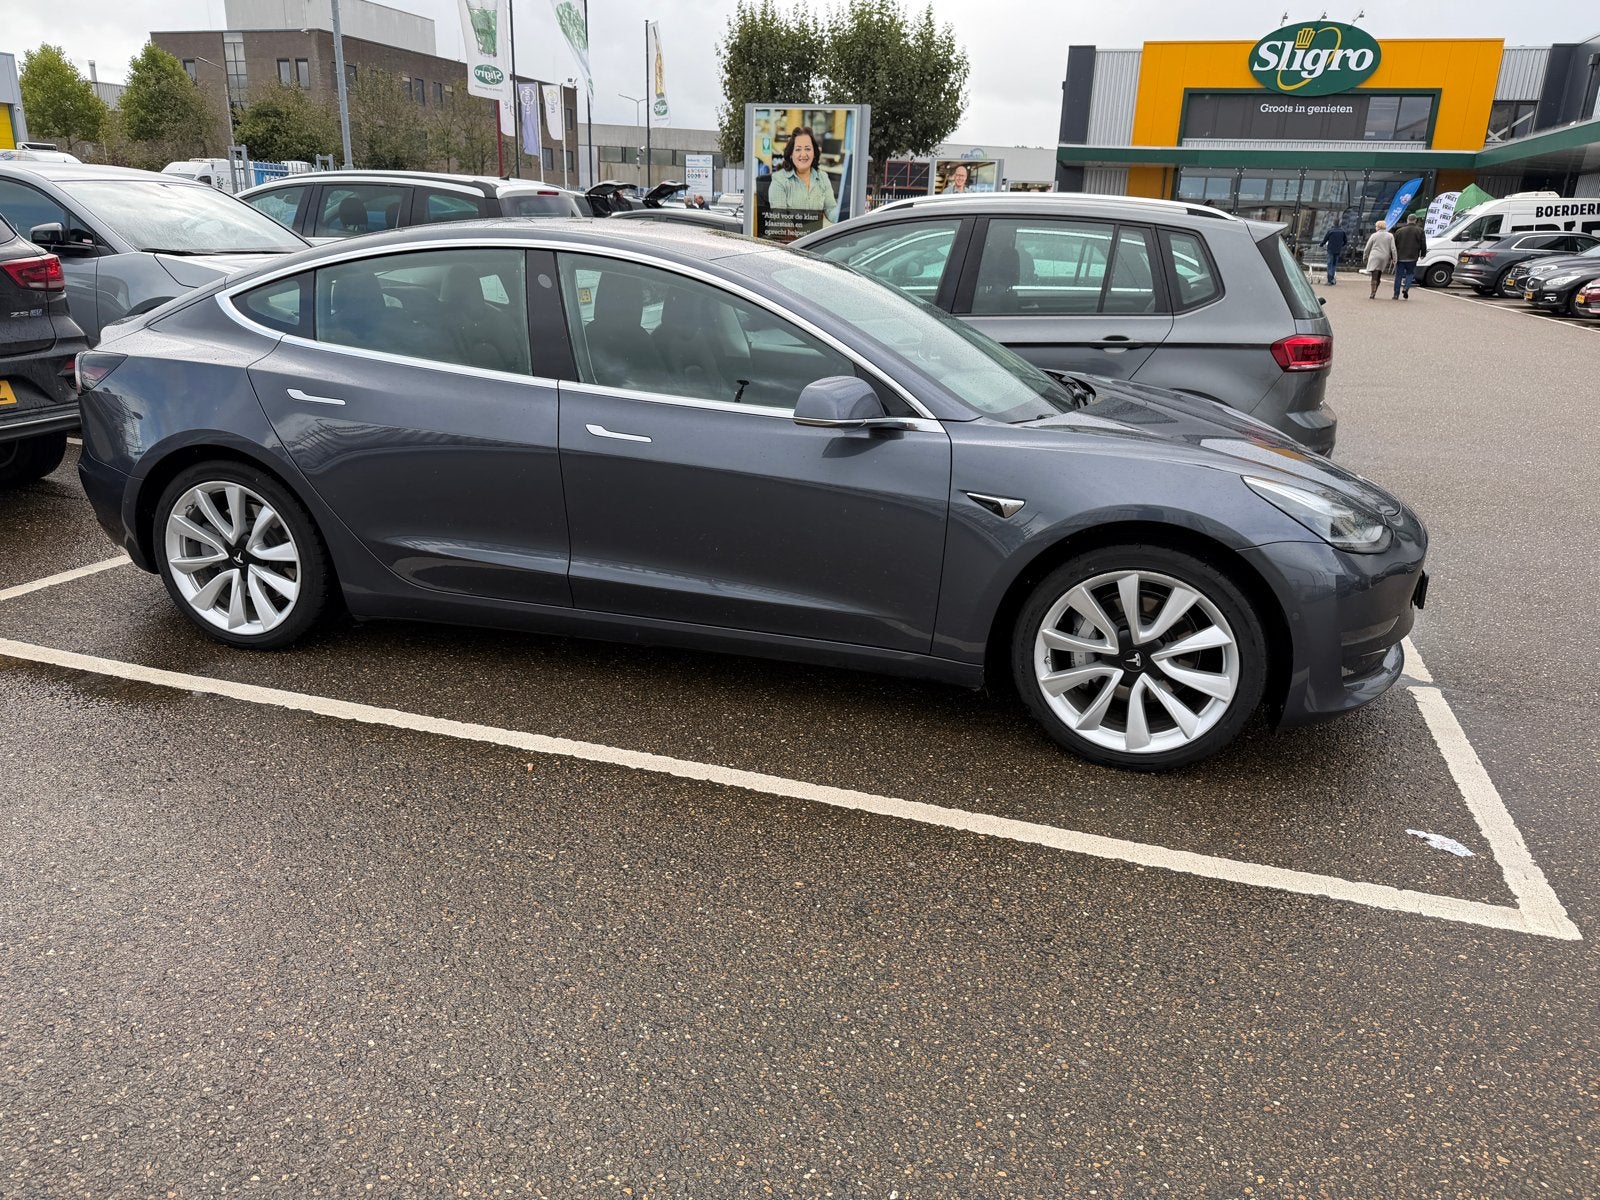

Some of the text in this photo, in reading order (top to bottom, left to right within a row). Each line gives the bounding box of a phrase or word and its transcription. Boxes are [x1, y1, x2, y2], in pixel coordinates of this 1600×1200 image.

[1253, 41, 1374, 79] Sligro
[1260, 103, 1353, 115] Groots in genieten
[804, 213, 819, 221] klant
[765, 220, 795, 228] klaarstaan
[765, 229, 787, 237] oprecht
